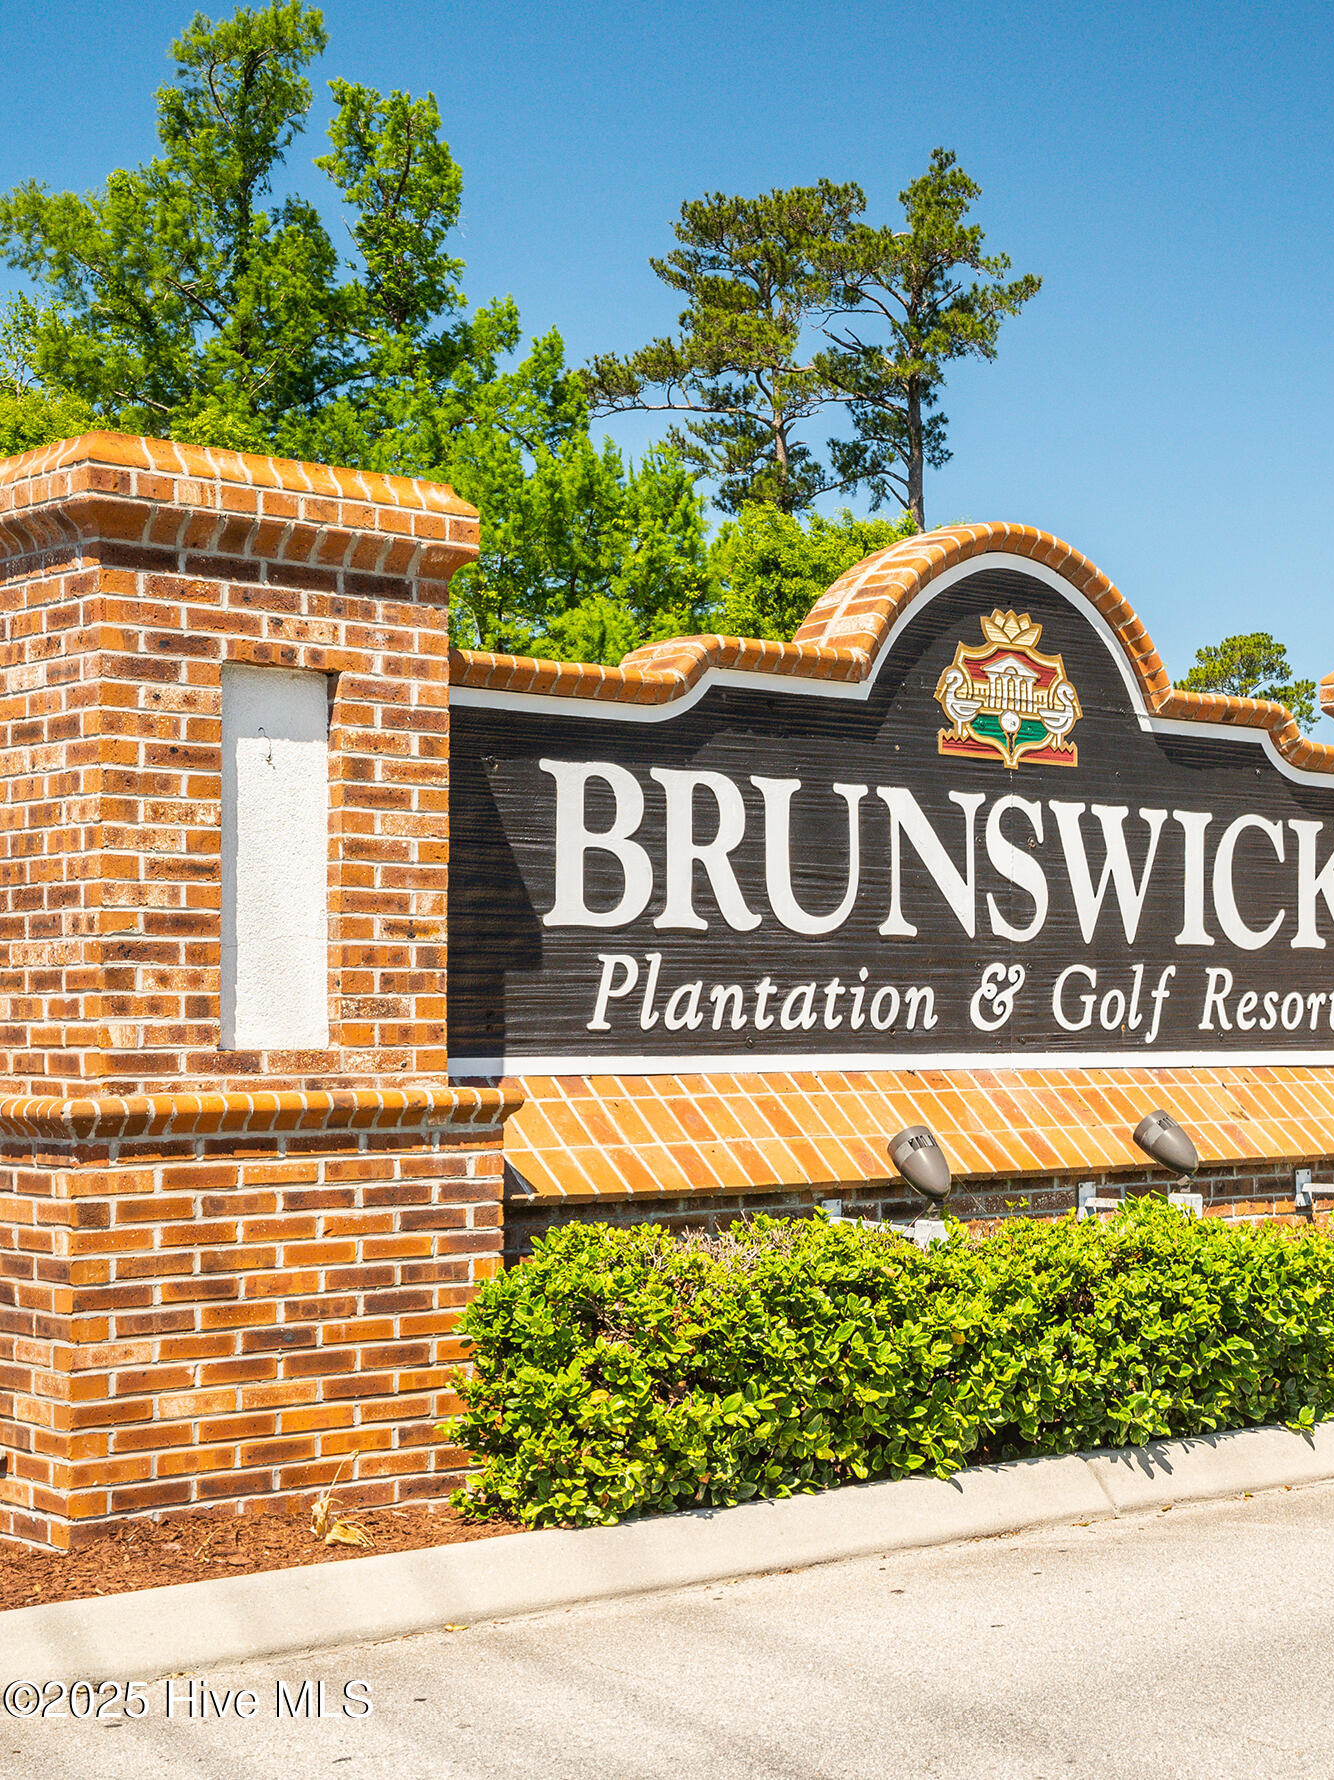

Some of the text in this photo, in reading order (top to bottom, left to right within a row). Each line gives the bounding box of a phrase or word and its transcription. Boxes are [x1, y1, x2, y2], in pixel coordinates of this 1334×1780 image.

[586, 953, 939, 1031] Plantation
[969, 963, 1026, 1032] &
[1051, 963, 1177, 1044] Golf
